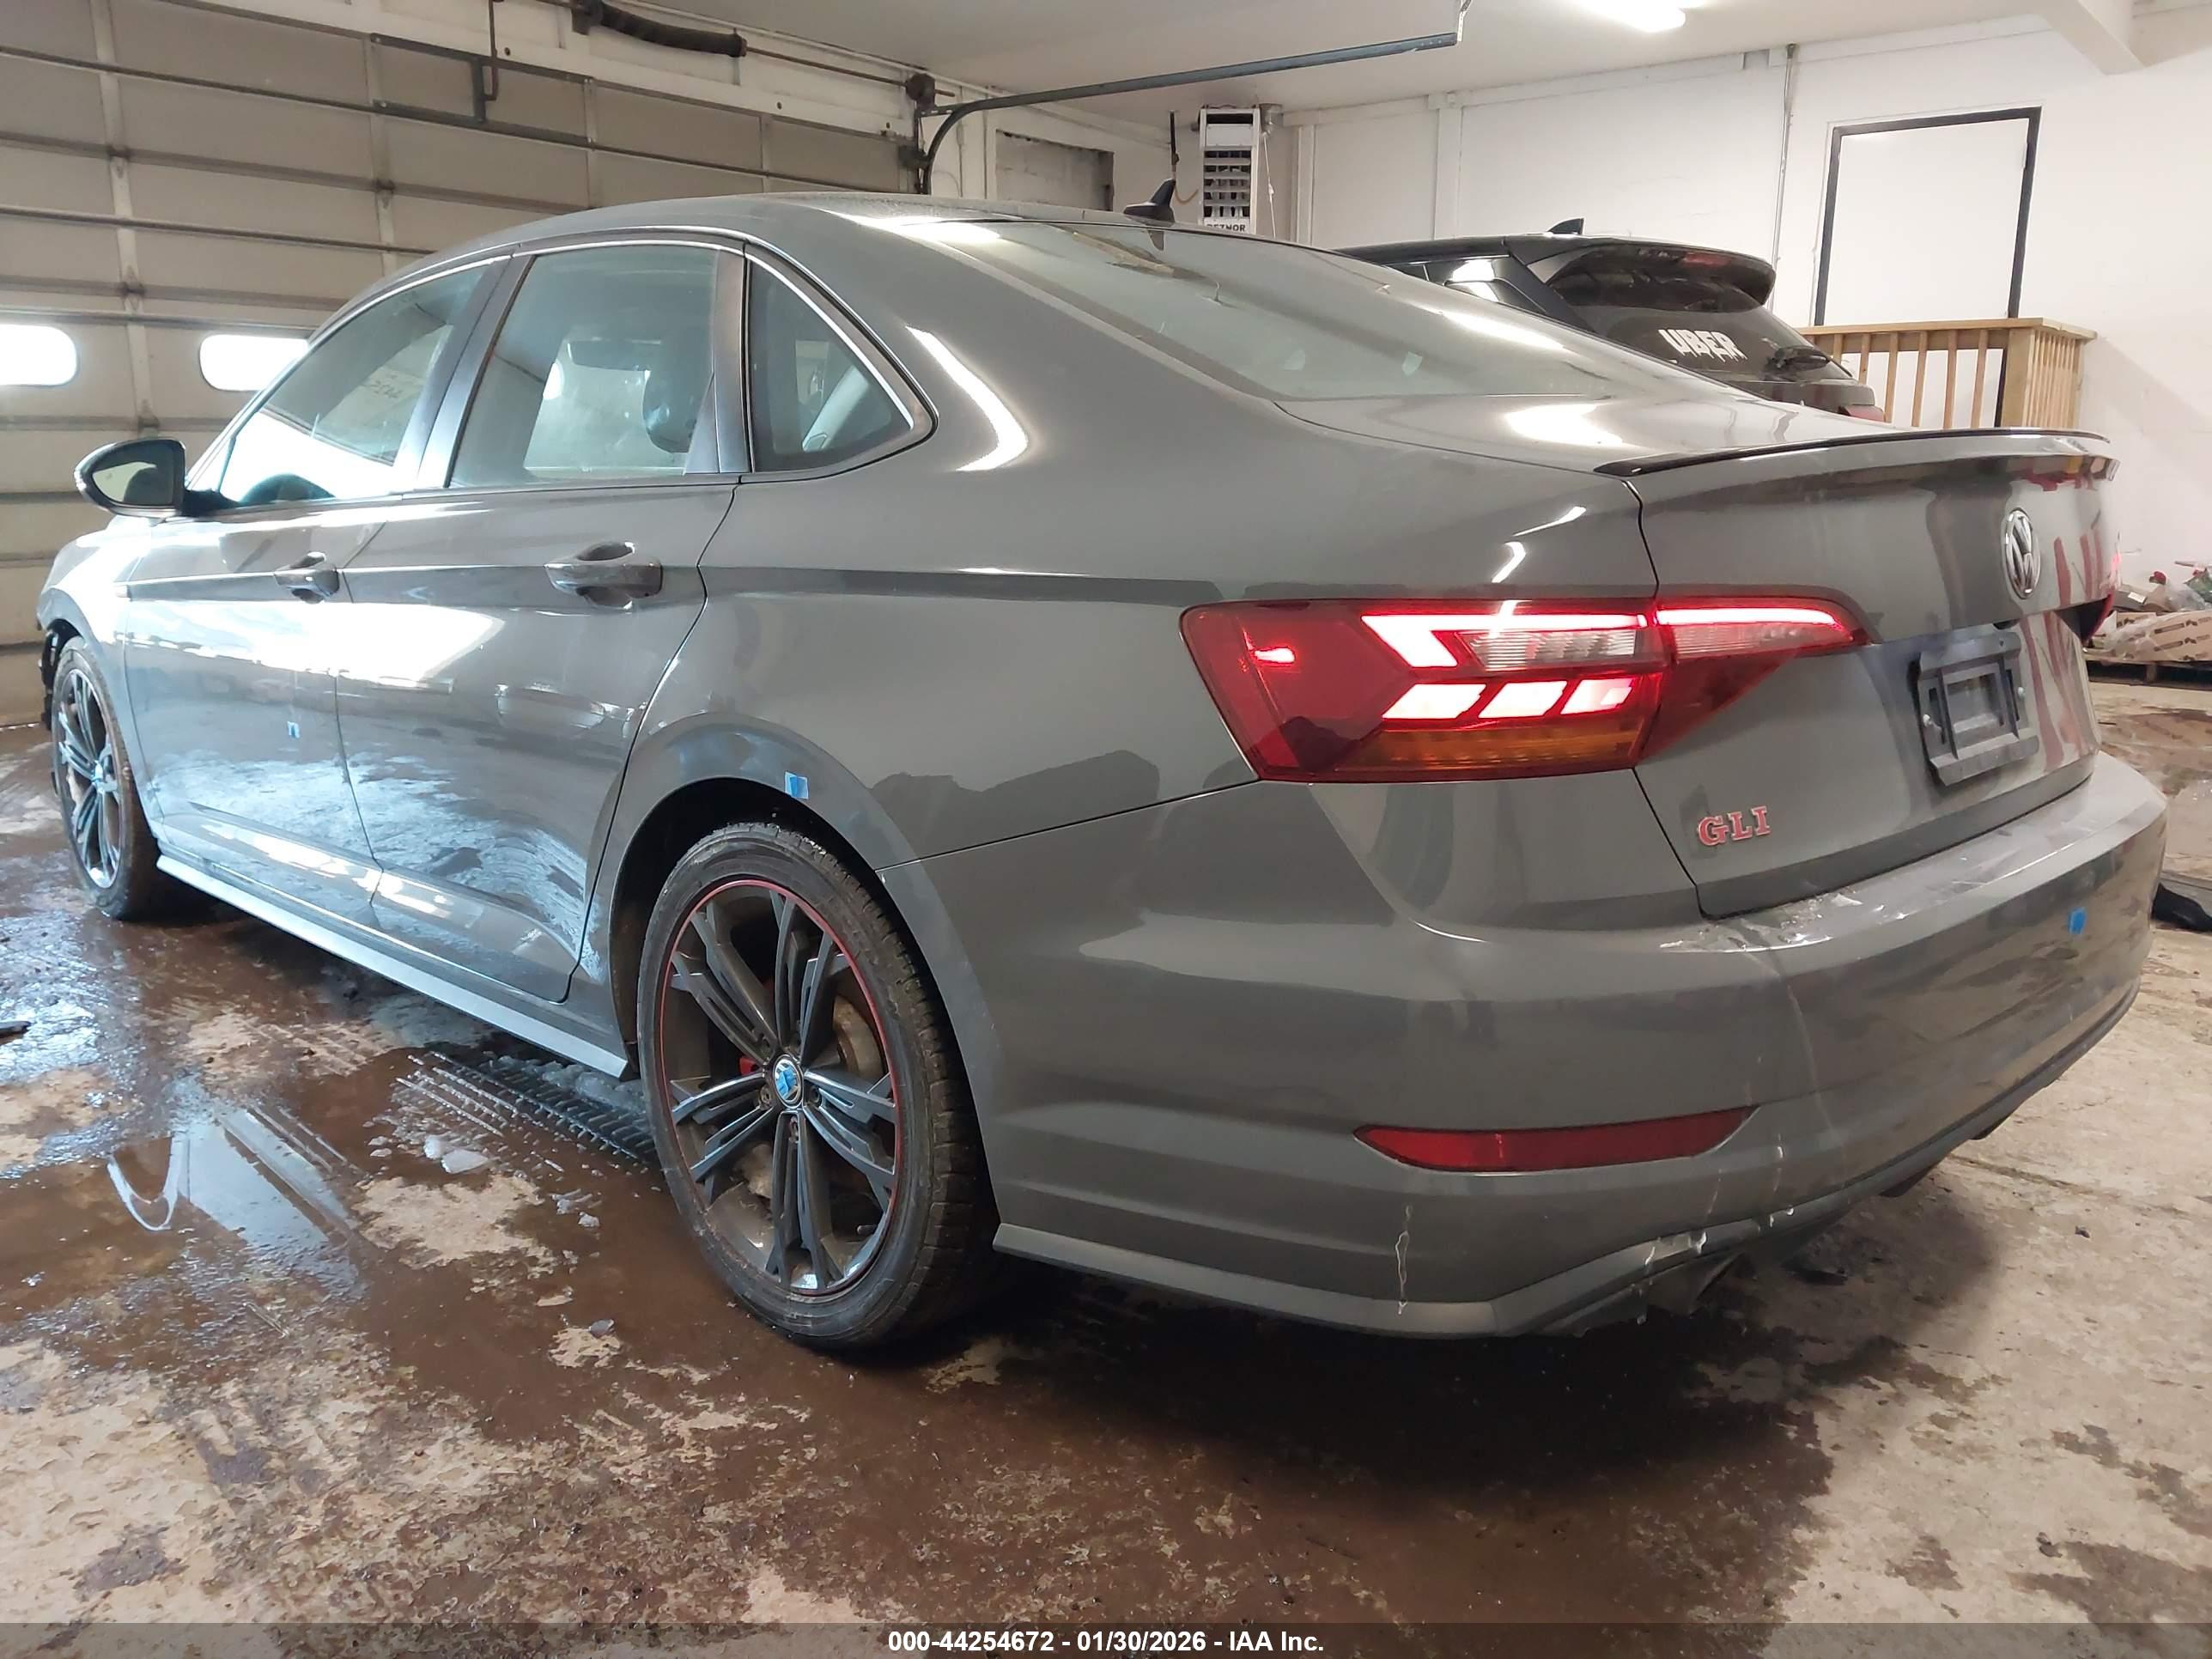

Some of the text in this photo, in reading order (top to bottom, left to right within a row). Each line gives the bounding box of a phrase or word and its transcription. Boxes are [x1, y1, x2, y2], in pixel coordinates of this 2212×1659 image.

[1206, 223, 1246, 232] ZNOR
[1658, 329, 1747, 362] UBER
[1697, 805, 1771, 846] GLI
